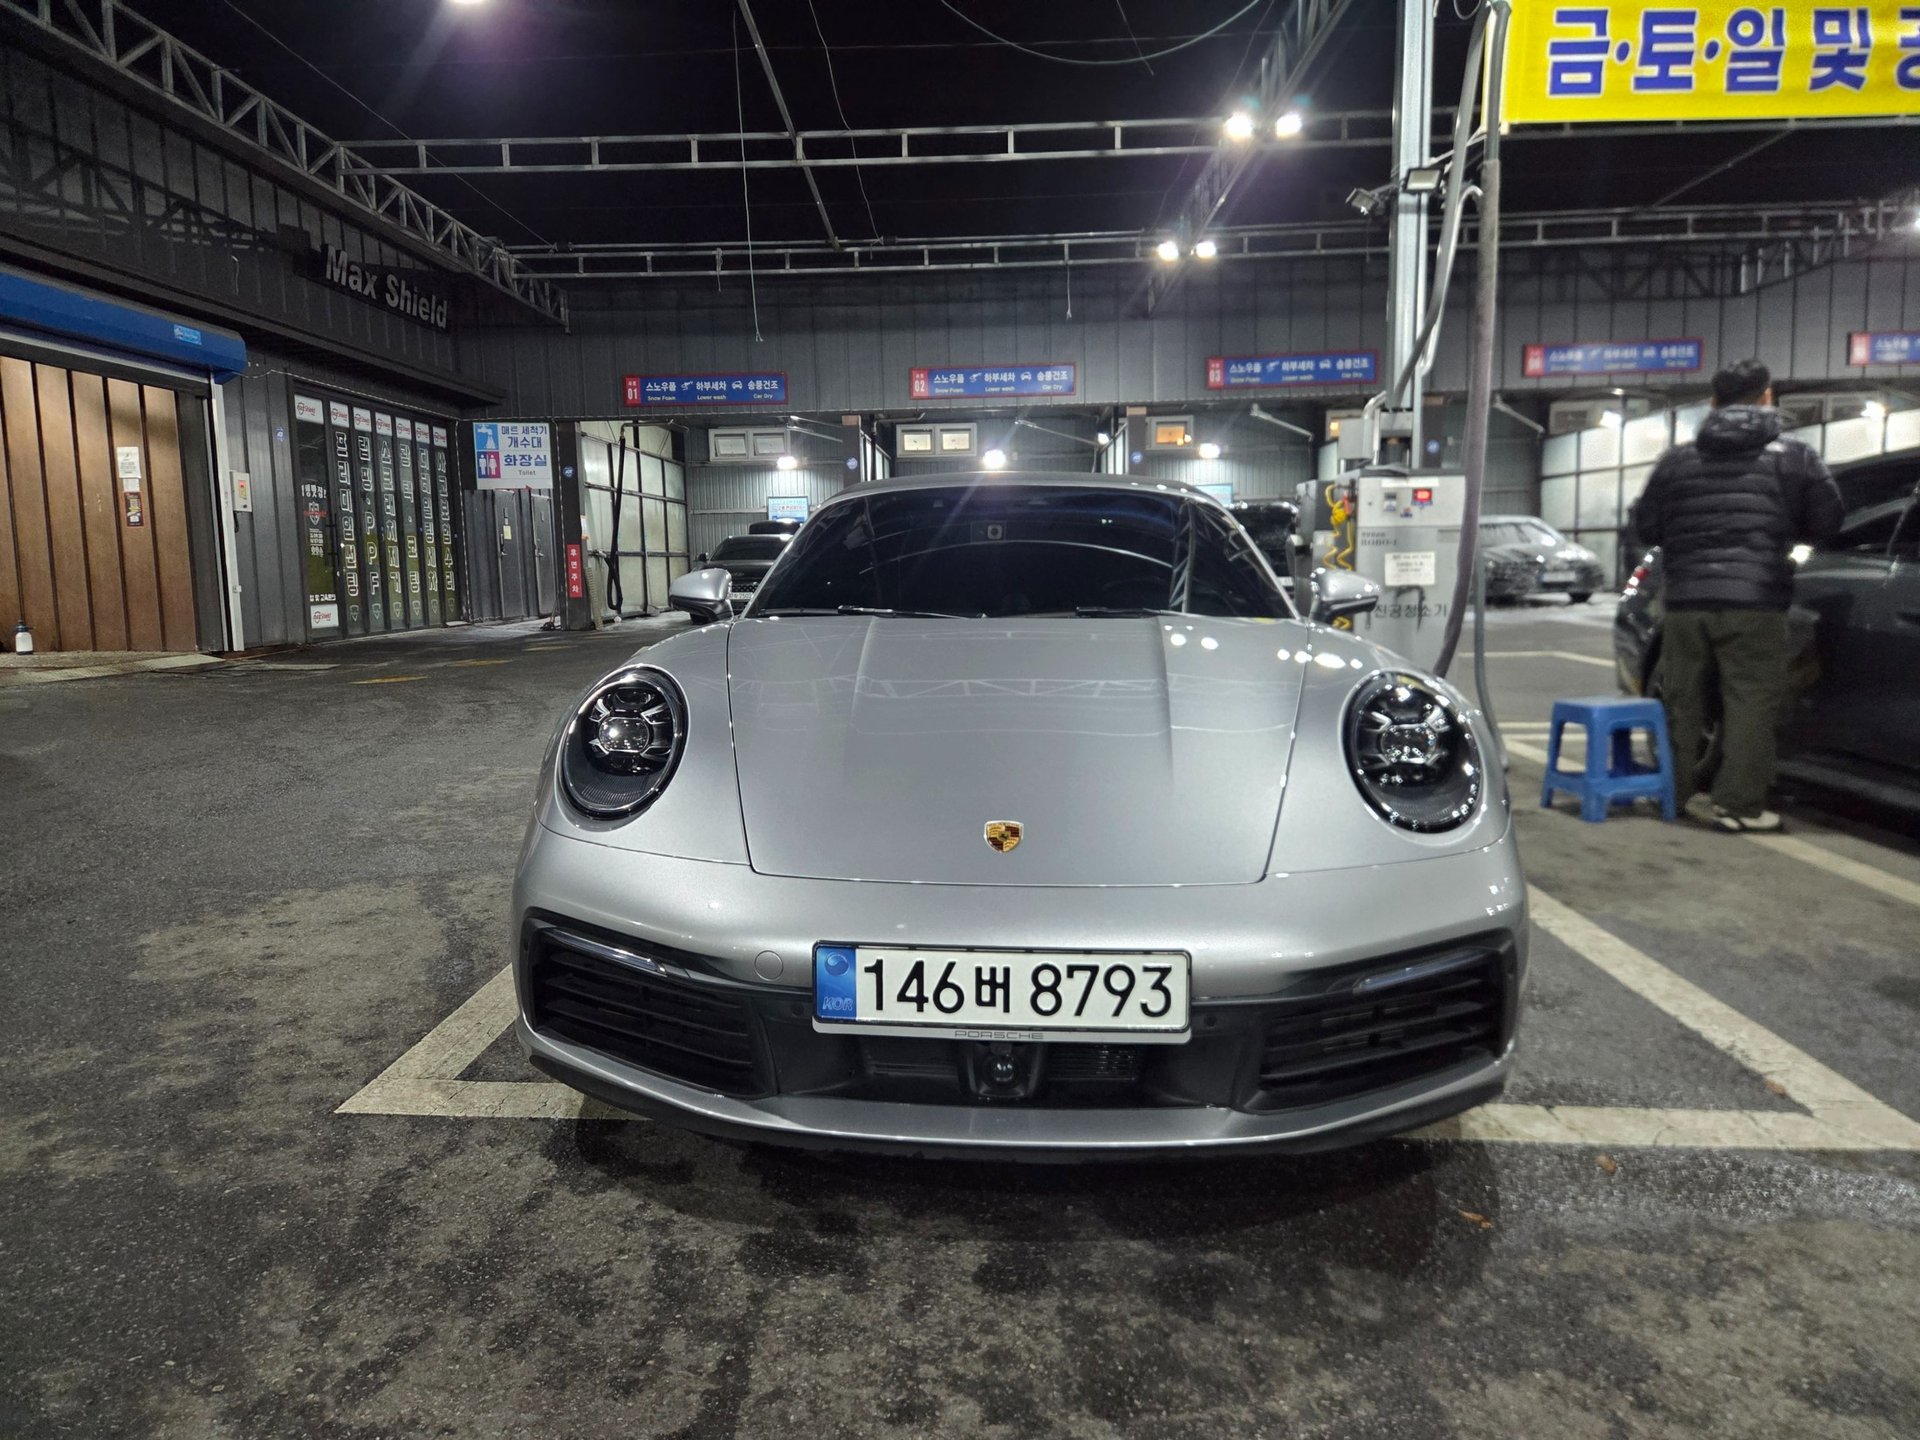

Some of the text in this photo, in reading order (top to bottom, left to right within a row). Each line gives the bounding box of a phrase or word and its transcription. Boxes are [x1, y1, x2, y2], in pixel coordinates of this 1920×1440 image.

[1548, 8, 1786, 95] 금·토·일
[1808, 7, 1873, 92] 및
[326, 244, 448, 329] Max Shield
[1282, 359, 1314, 371] 하부세차
[934, 370, 1068, 384] 스노우폼 하부세차 송풍건조
[646, 380, 778, 392] 스노우폼 하부세차 송풍건조
[914, 381, 925, 392] 02
[627, 388, 638, 400] 01
[501, 425, 548, 435] 매트 세척기
[507, 436, 542, 449] 개수대
[503, 453, 548, 467] 화장실
[570, 548, 579, 593] 후면주차
[1374, 603, 1447, 619] 진공청소기
[863, 958, 1172, 1018] 146버 8793
[822, 995, 853, 1011] KOR
[955, 1030, 1044, 1040] PORSCHE
